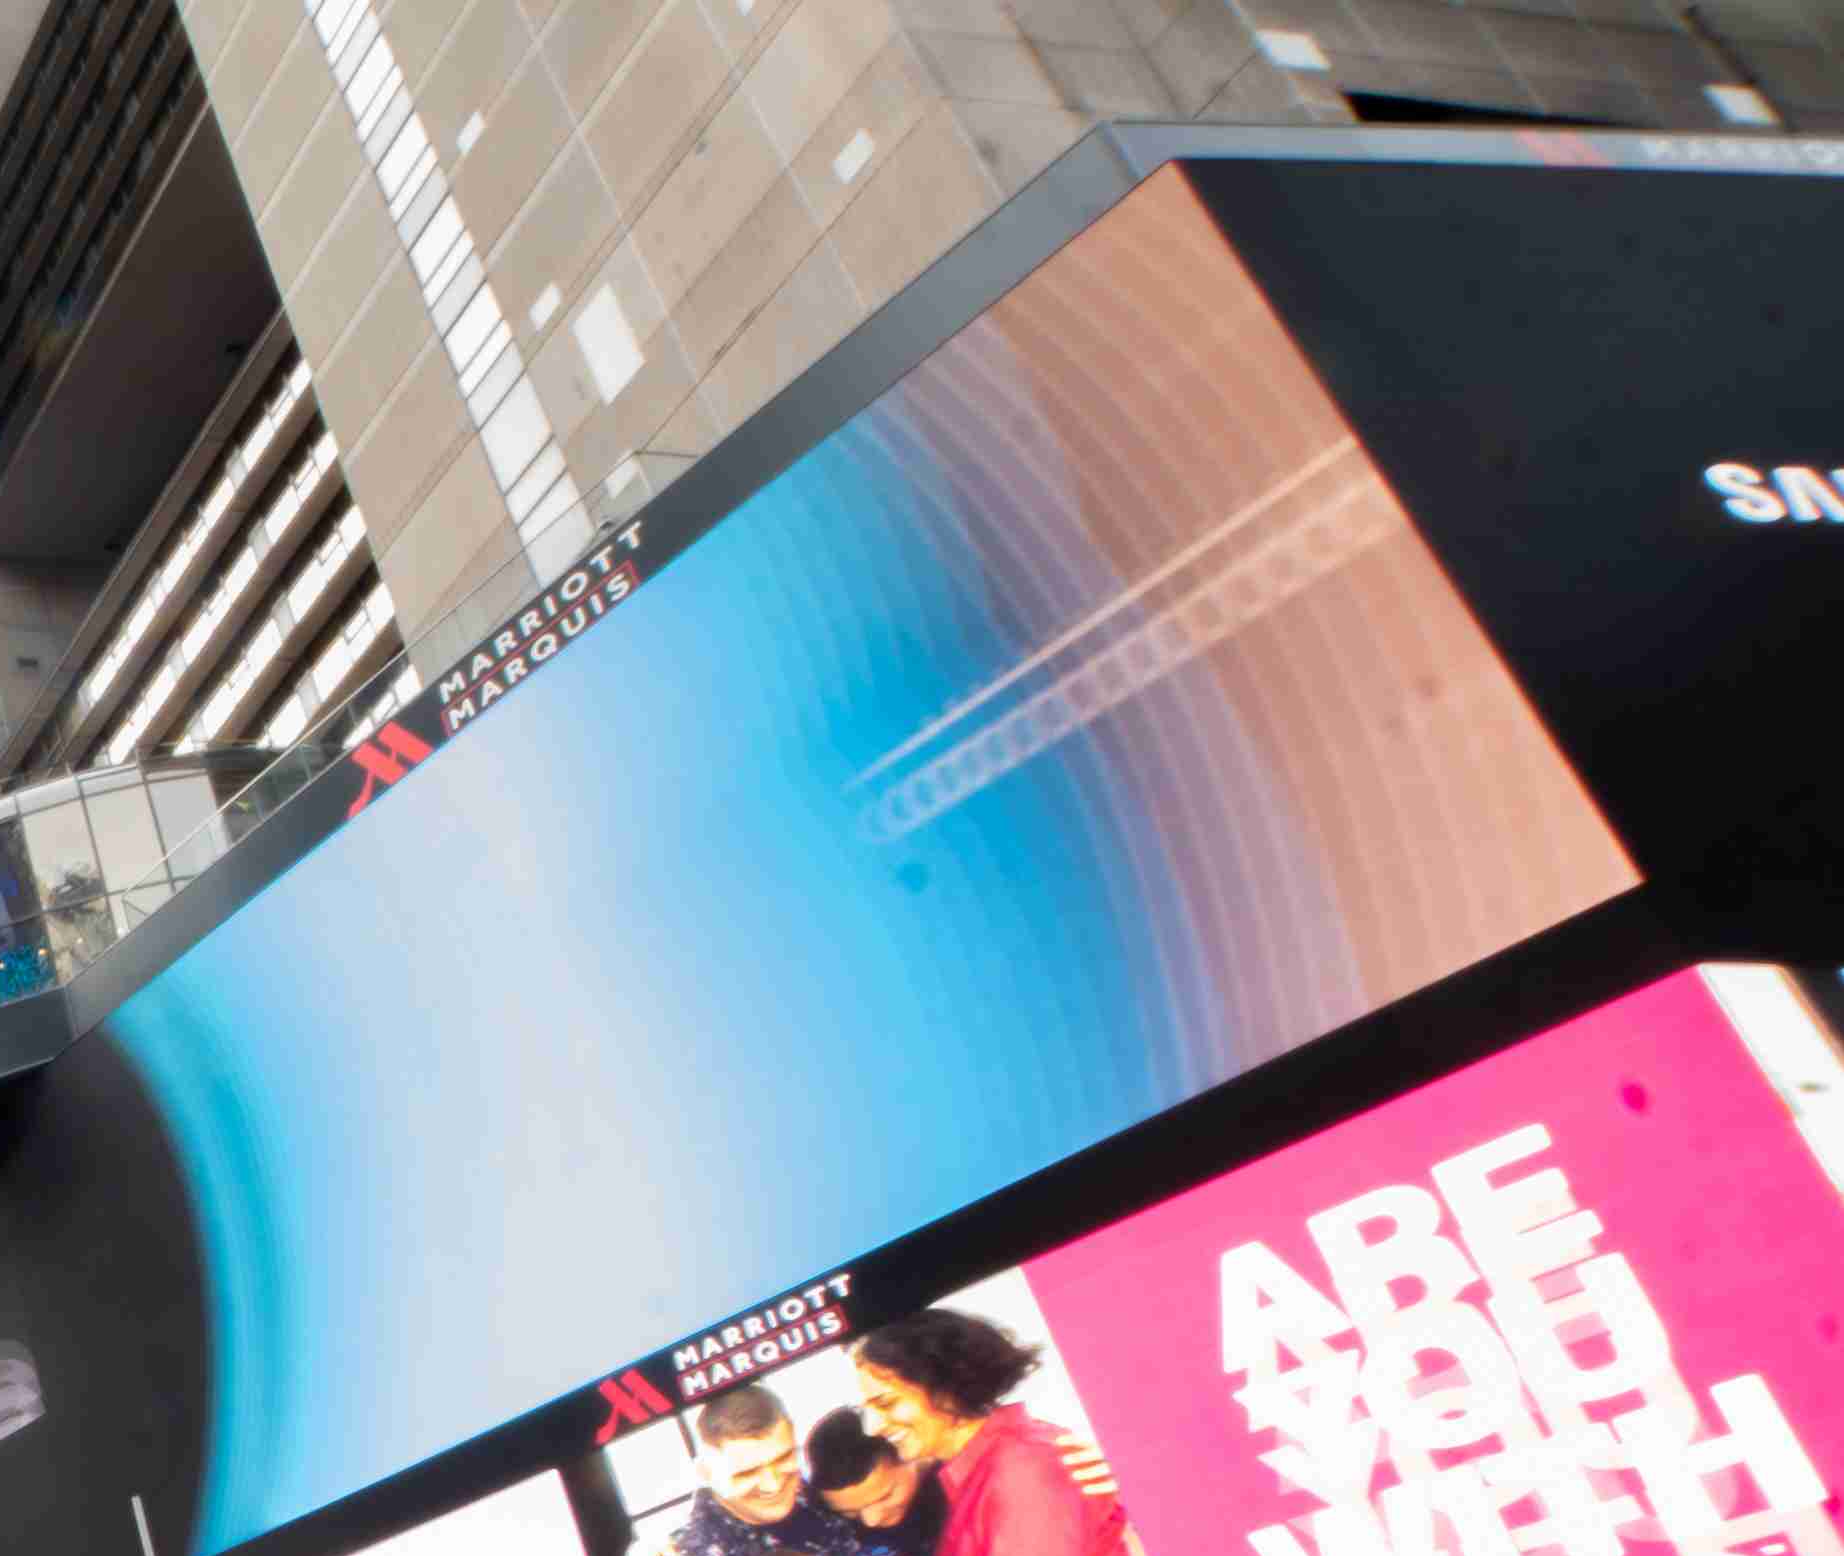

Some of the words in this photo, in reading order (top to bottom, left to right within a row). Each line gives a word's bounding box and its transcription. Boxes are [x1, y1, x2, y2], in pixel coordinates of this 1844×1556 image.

[439, 520, 643, 705] MARRIOTT
[448, 573, 634, 732] MARQUIS
[672, 1273, 852, 1372] MARRIOTT
[1220, 1123, 1577, 1375] ARE
[681, 1311, 842, 1397] MARQUIS
